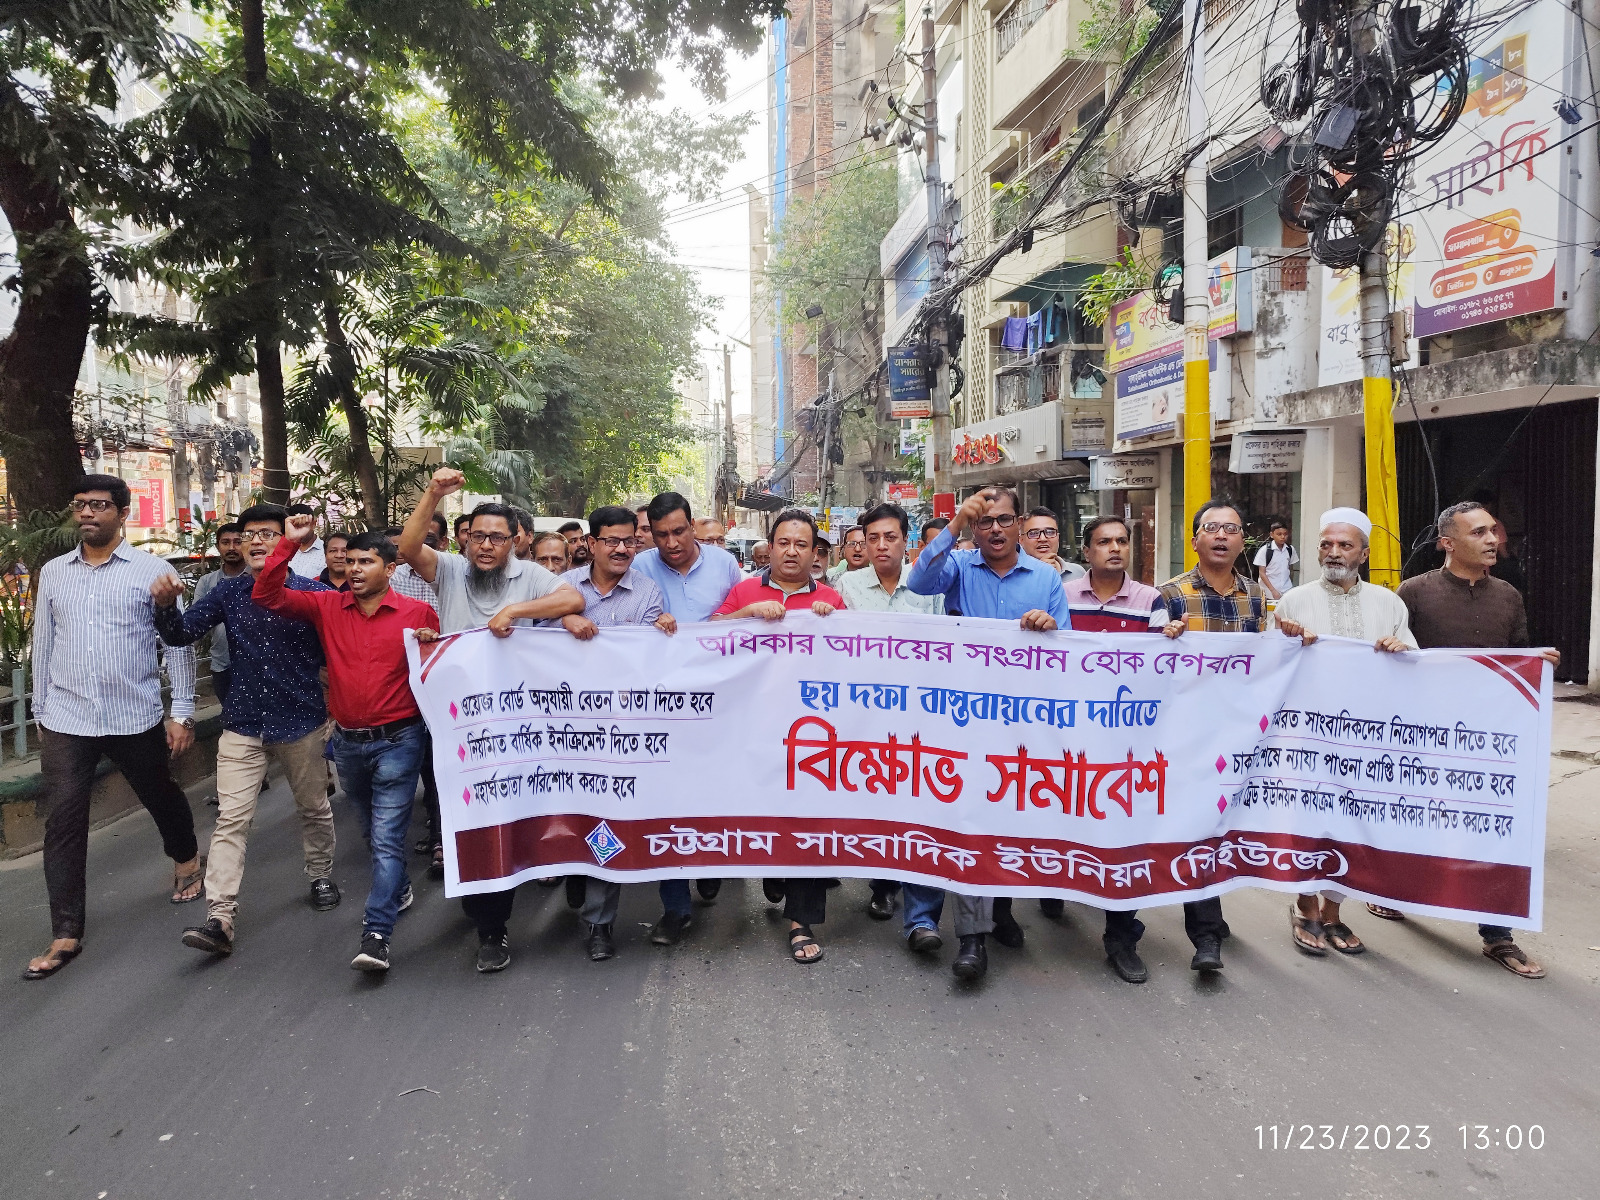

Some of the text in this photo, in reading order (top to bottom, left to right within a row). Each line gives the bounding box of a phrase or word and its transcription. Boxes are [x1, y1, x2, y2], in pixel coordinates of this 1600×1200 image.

[1504, 77, 1523, 93] ১০ম
[152, 481, 161, 525] HITACHI
[696, 629, 1255, 676] অধিকার আদায়ের সংগ্রাম হোক বেগবান
[461, 680, 715, 717] ওয়েজ বোর্ড অনুযায়ী বেতন ভাতা দিতে হবে
[798, 680, 1161, 728] ছয় দফা বাস্তবায়নের দাবিতে
[467, 722, 669, 761] নিয়মিত বার্ষিক ইনক্রিমেন্ট দিতে হবে
[1305, 709, 1387, 743] সাংবাদিকদের
[1390, 715, 1450, 750] নিয়োগপত্র
[1454, 721, 1487, 751] দিতে
[1491, 732, 1518, 758] হবে
[473, 765, 637, 806] মহার্ঘভাতা পরিশোধ করতে হবে
[783, 716, 1168, 820] বিক্ষোভ সমাবেশ
[1286, 747, 1319, 772] ন্যায্য
[1323, 752, 1363, 781] পাওনা
[1366, 754, 1395, 784] প্রাপ্তি
[1399, 756, 1441, 787] নিশ্চিত
[1444, 768, 1485, 792] করতে
[1489, 773, 1516, 799] হবে
[1262, 778, 1298, 810] ইউনিয়ন
[1301, 782, 1335, 814] কার্যক্রম
[1339, 789, 1386, 824] পরিচালনার
[1389, 796, 1425, 827] অধিকার
[1428, 799, 1460, 830] নিশ্চিত
[1462, 811, 1491, 835] করতে
[1494, 814, 1514, 839] হবে
[643, 824, 1349, 888] চট্টগ্রাম সাংবাদিক ইউনিয়ন (সিইউজে)
